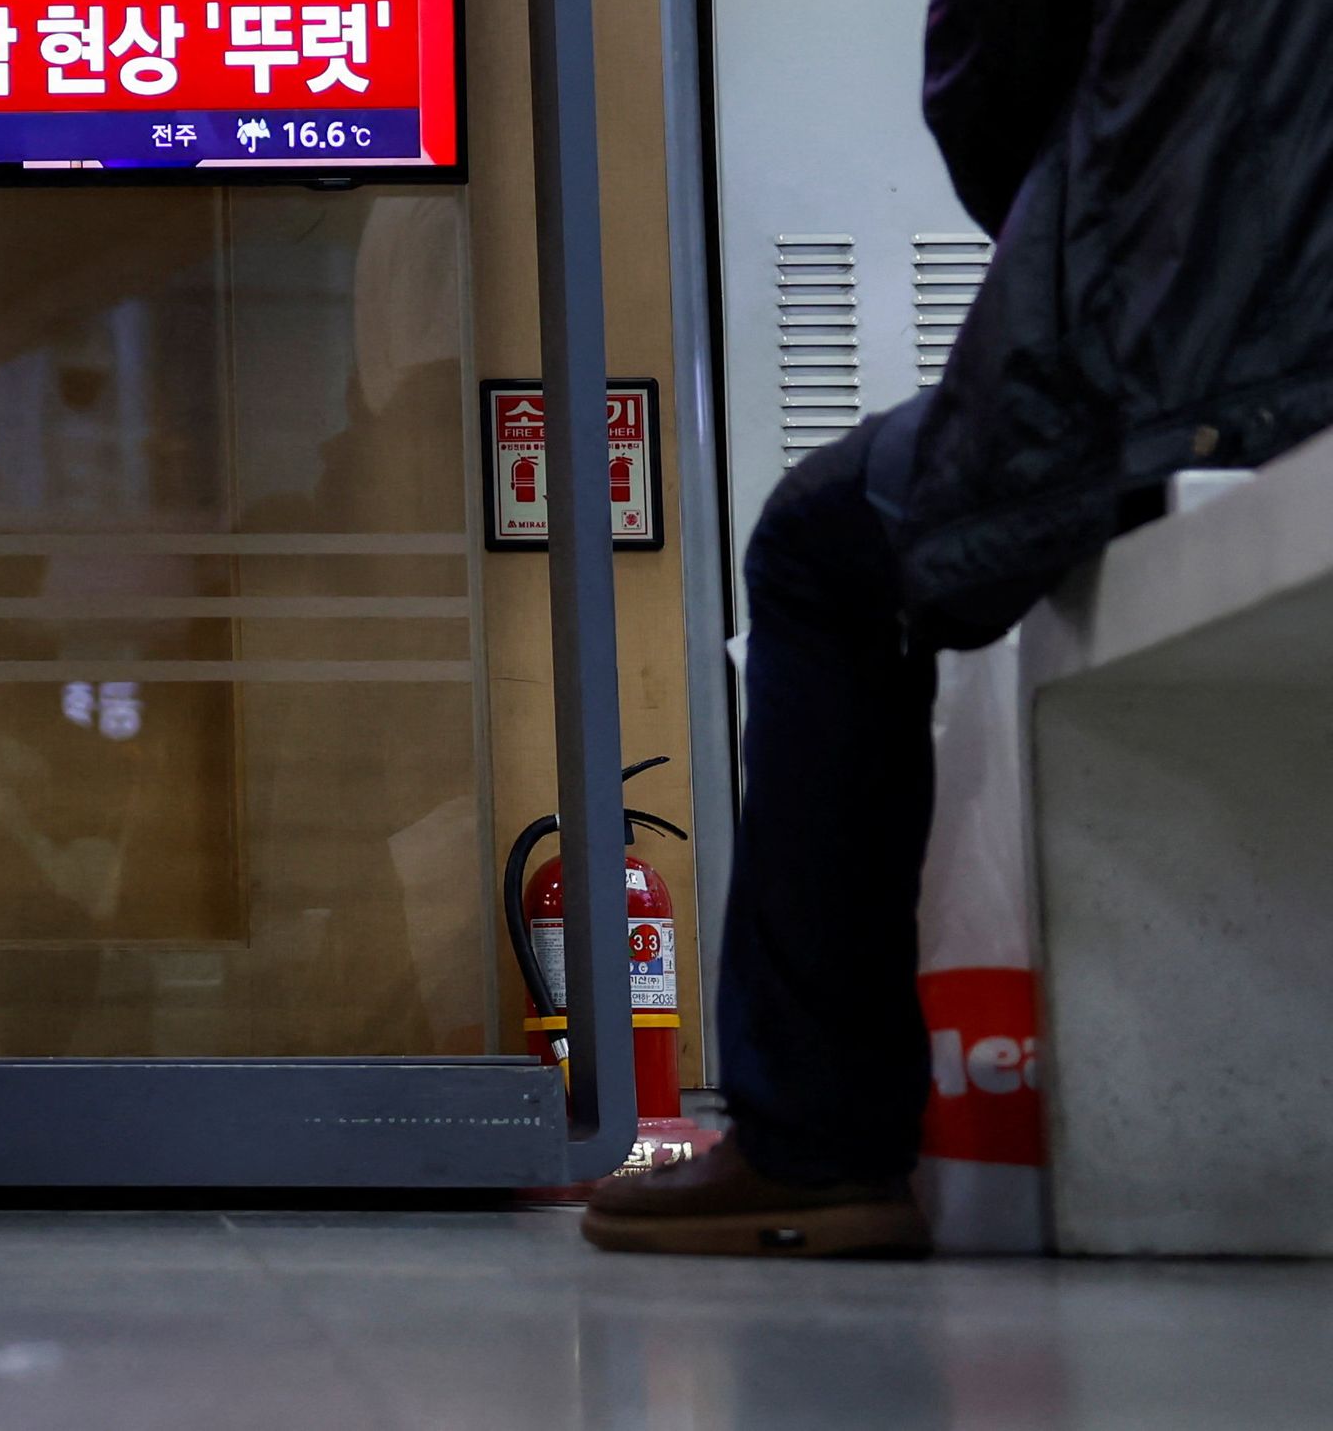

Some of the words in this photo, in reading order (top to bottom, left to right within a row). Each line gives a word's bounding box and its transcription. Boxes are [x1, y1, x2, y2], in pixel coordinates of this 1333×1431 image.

[36, 3, 185, 97] 현상
[206, 0, 391, 94] '뚜렷'
[151, 122, 198, 149] 전주
[504, 399, 636, 427] 소기
[504, 427, 533, 438] FIRE
[633, 934, 658, 951] 3.3
